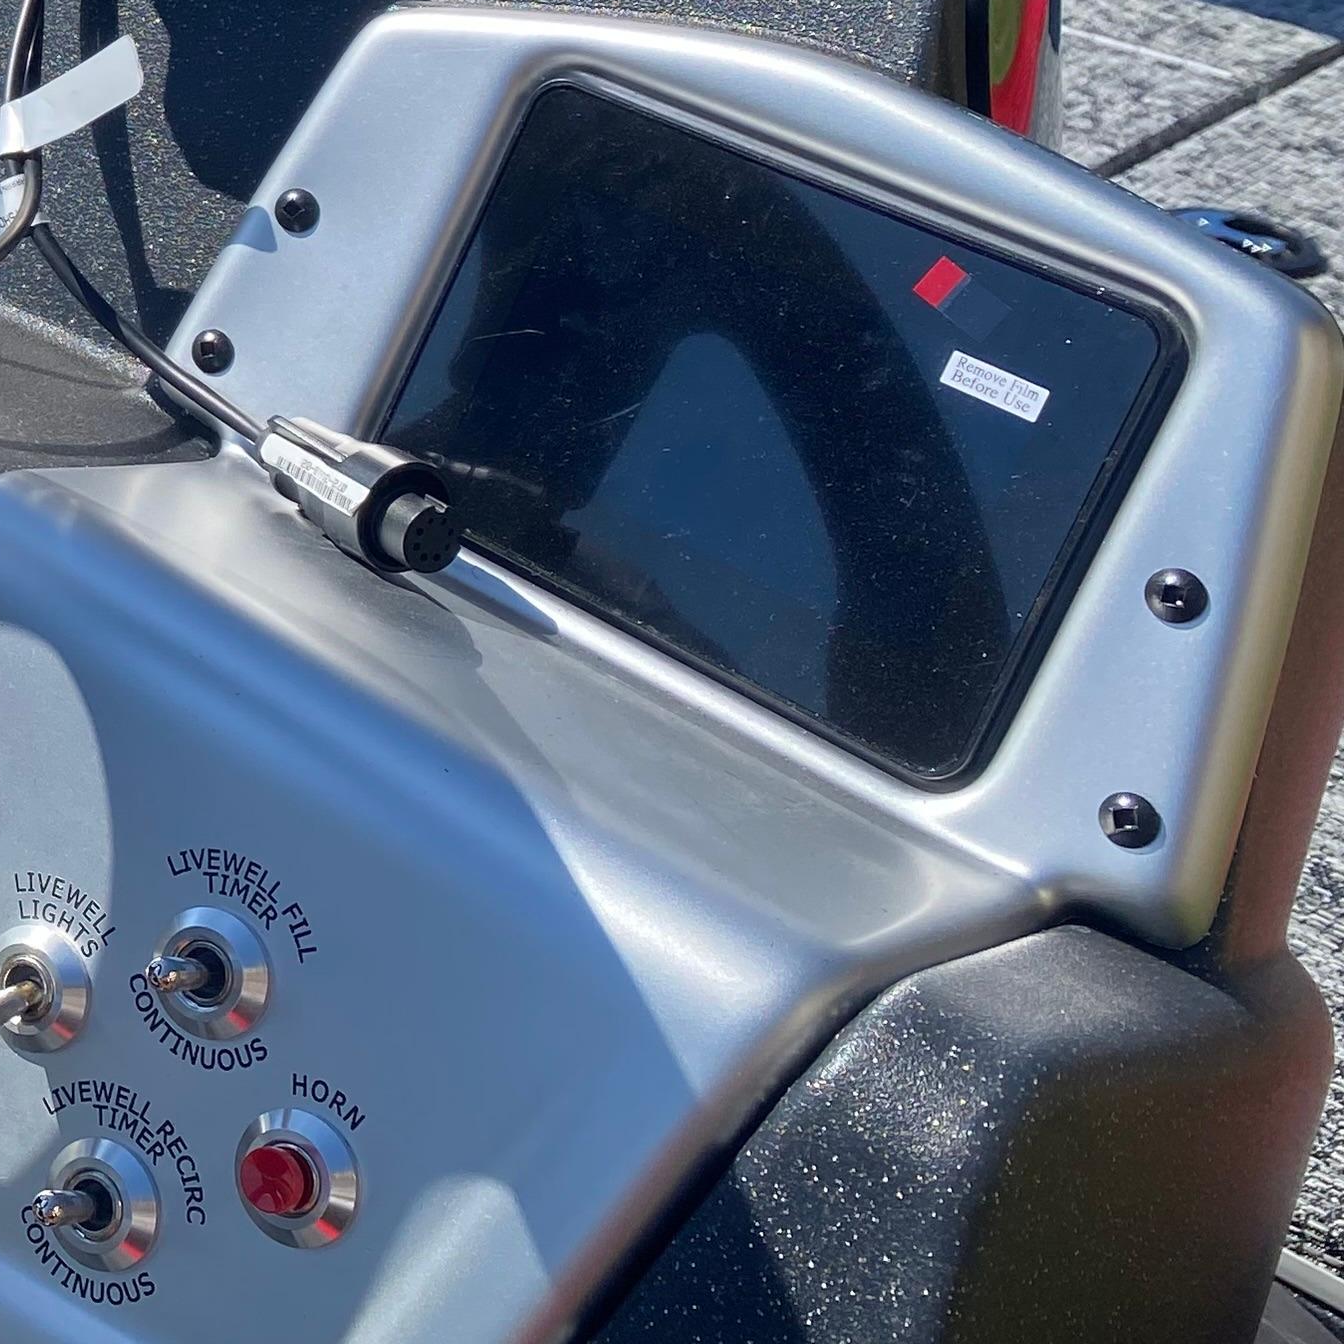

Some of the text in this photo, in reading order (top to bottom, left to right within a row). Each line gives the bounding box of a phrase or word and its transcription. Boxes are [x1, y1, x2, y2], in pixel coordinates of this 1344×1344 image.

[950, 369, 1032, 413] Before Use
[955, 355, 1040, 402] Remove Film
[14, 871, 117, 947] LIVEWELL
[18, 900, 100, 959] LIGHTS
[166, 847, 318, 964] LIVEWELL FILL
[203, 871, 278, 931] TIMER
[128, 973, 269, 1072] CONTINUOUS
[291, 1073, 367, 1132] HORN
[42, 1080, 207, 1226] LIVEWELL RECIRC
[92, 1105, 165, 1166] TIMER
[20, 1205, 156, 1306] CONTINUOUS
